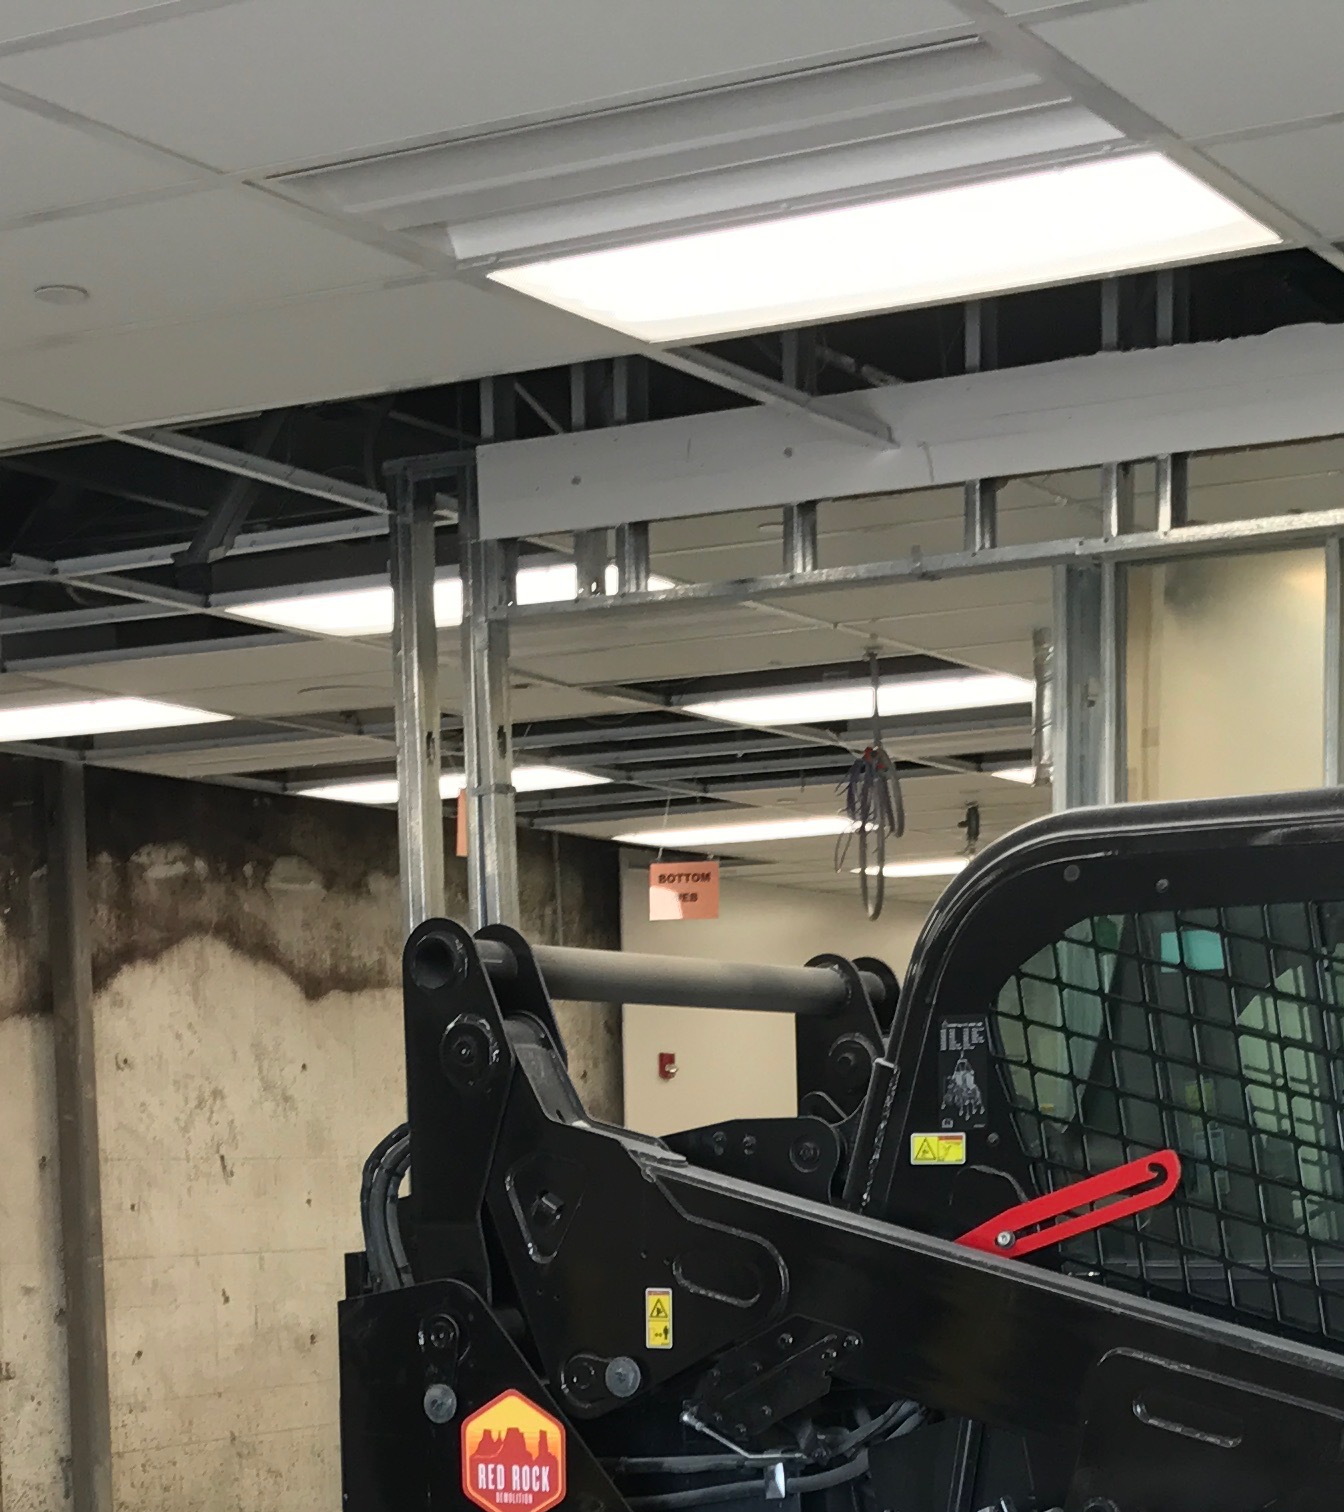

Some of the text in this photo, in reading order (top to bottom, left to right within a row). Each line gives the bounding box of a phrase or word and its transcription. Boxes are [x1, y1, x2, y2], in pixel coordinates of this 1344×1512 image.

[658, 872, 711, 884] BOTTOM
[478, 1463, 550, 1492] RED ROCK
